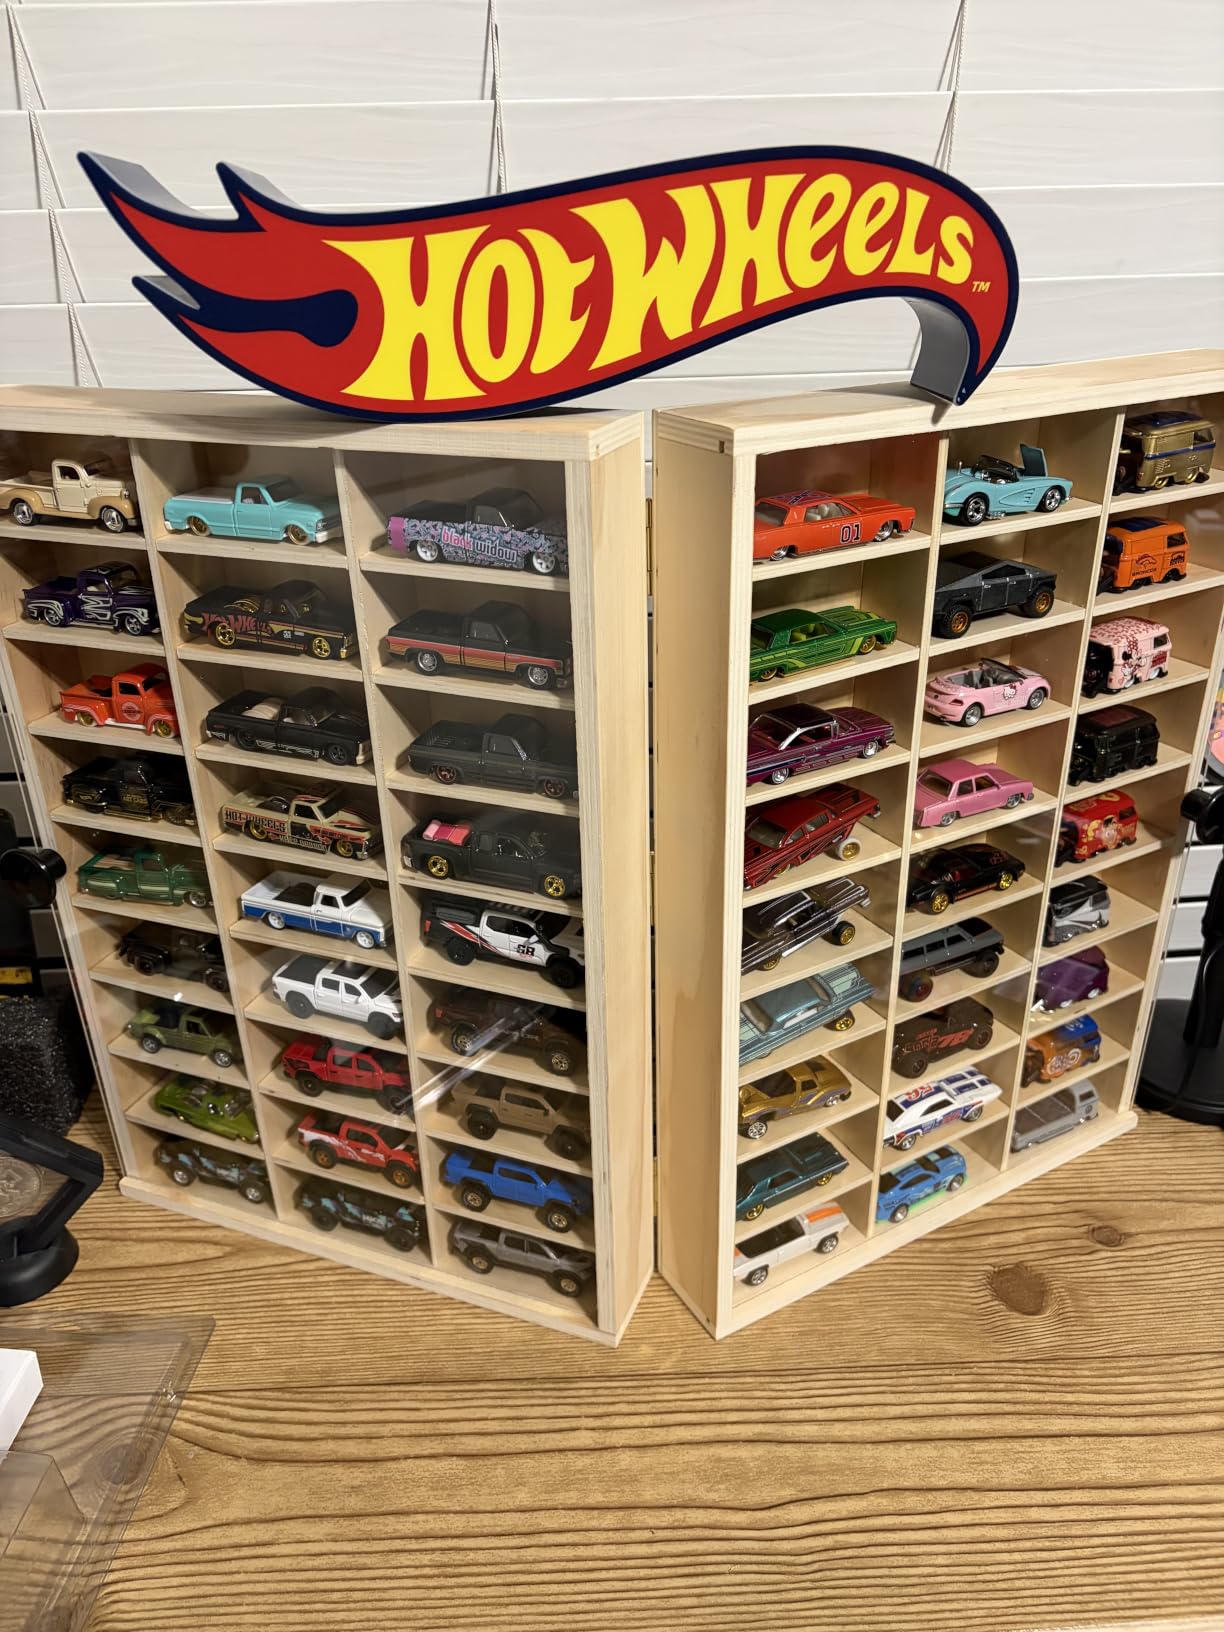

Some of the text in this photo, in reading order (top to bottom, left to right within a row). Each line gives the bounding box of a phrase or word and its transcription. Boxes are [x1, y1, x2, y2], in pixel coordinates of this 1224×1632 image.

[972, 281, 991, 292] TM
[442, 526, 517, 562] black widow
[840, 522, 861, 544] 01
